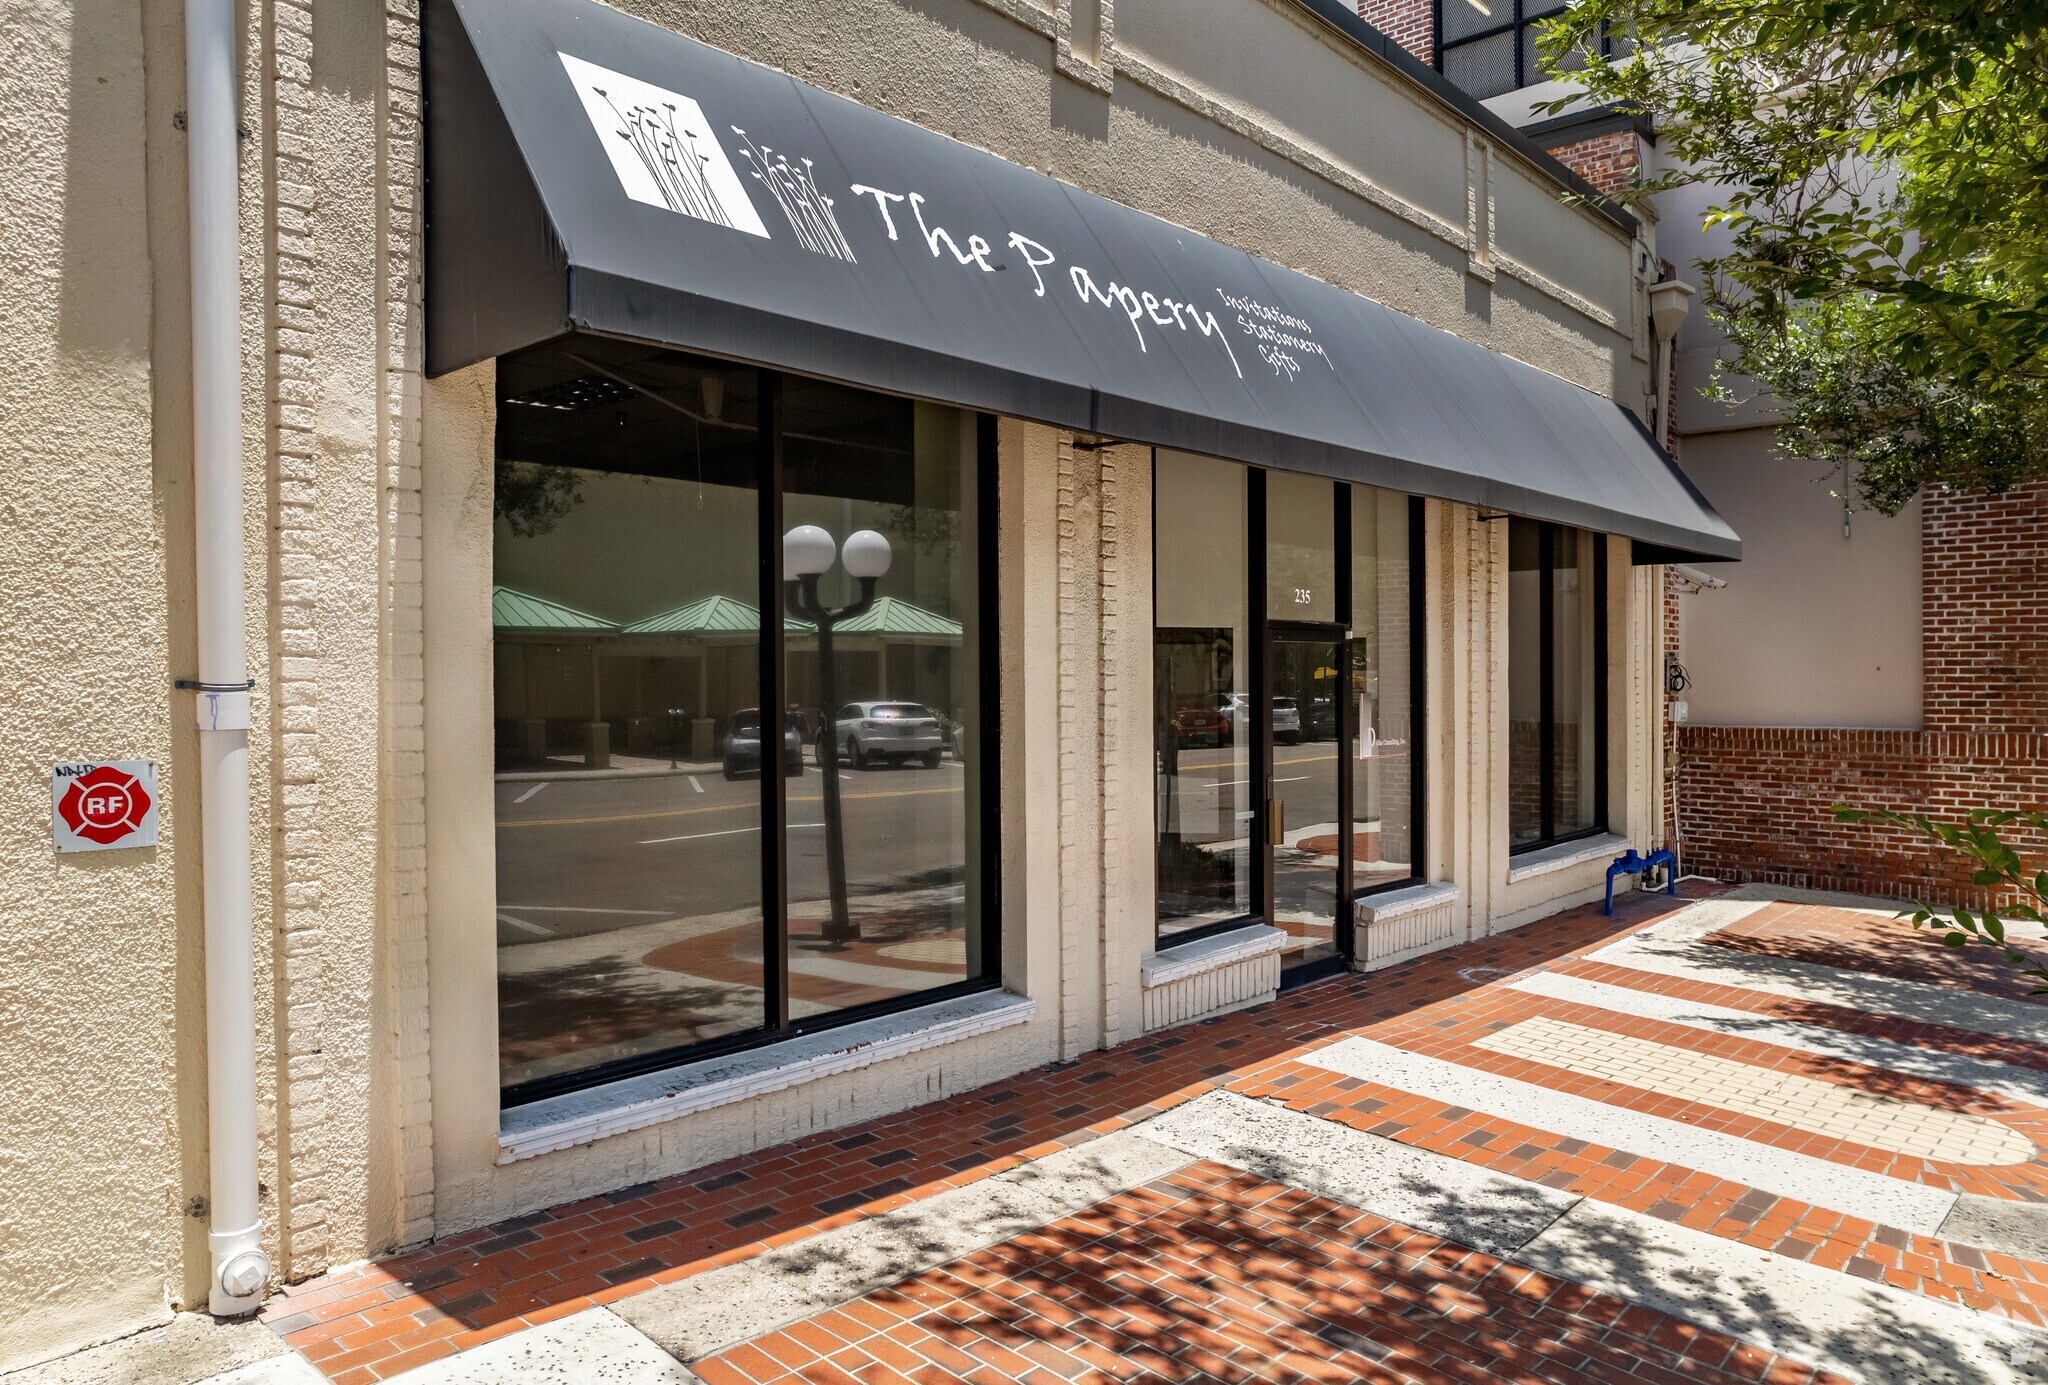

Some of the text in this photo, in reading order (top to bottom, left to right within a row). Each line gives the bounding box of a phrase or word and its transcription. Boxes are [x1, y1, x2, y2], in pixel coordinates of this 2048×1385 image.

[850, 183, 1242, 379] The Papery
[1216, 288, 1311, 333] Invitations
[1237, 314, 1334, 370] Stationery
[1258, 344, 1301, 382] Gifts
[1294, 588, 1311, 604] 235
[87, 796, 123, 815] RF
